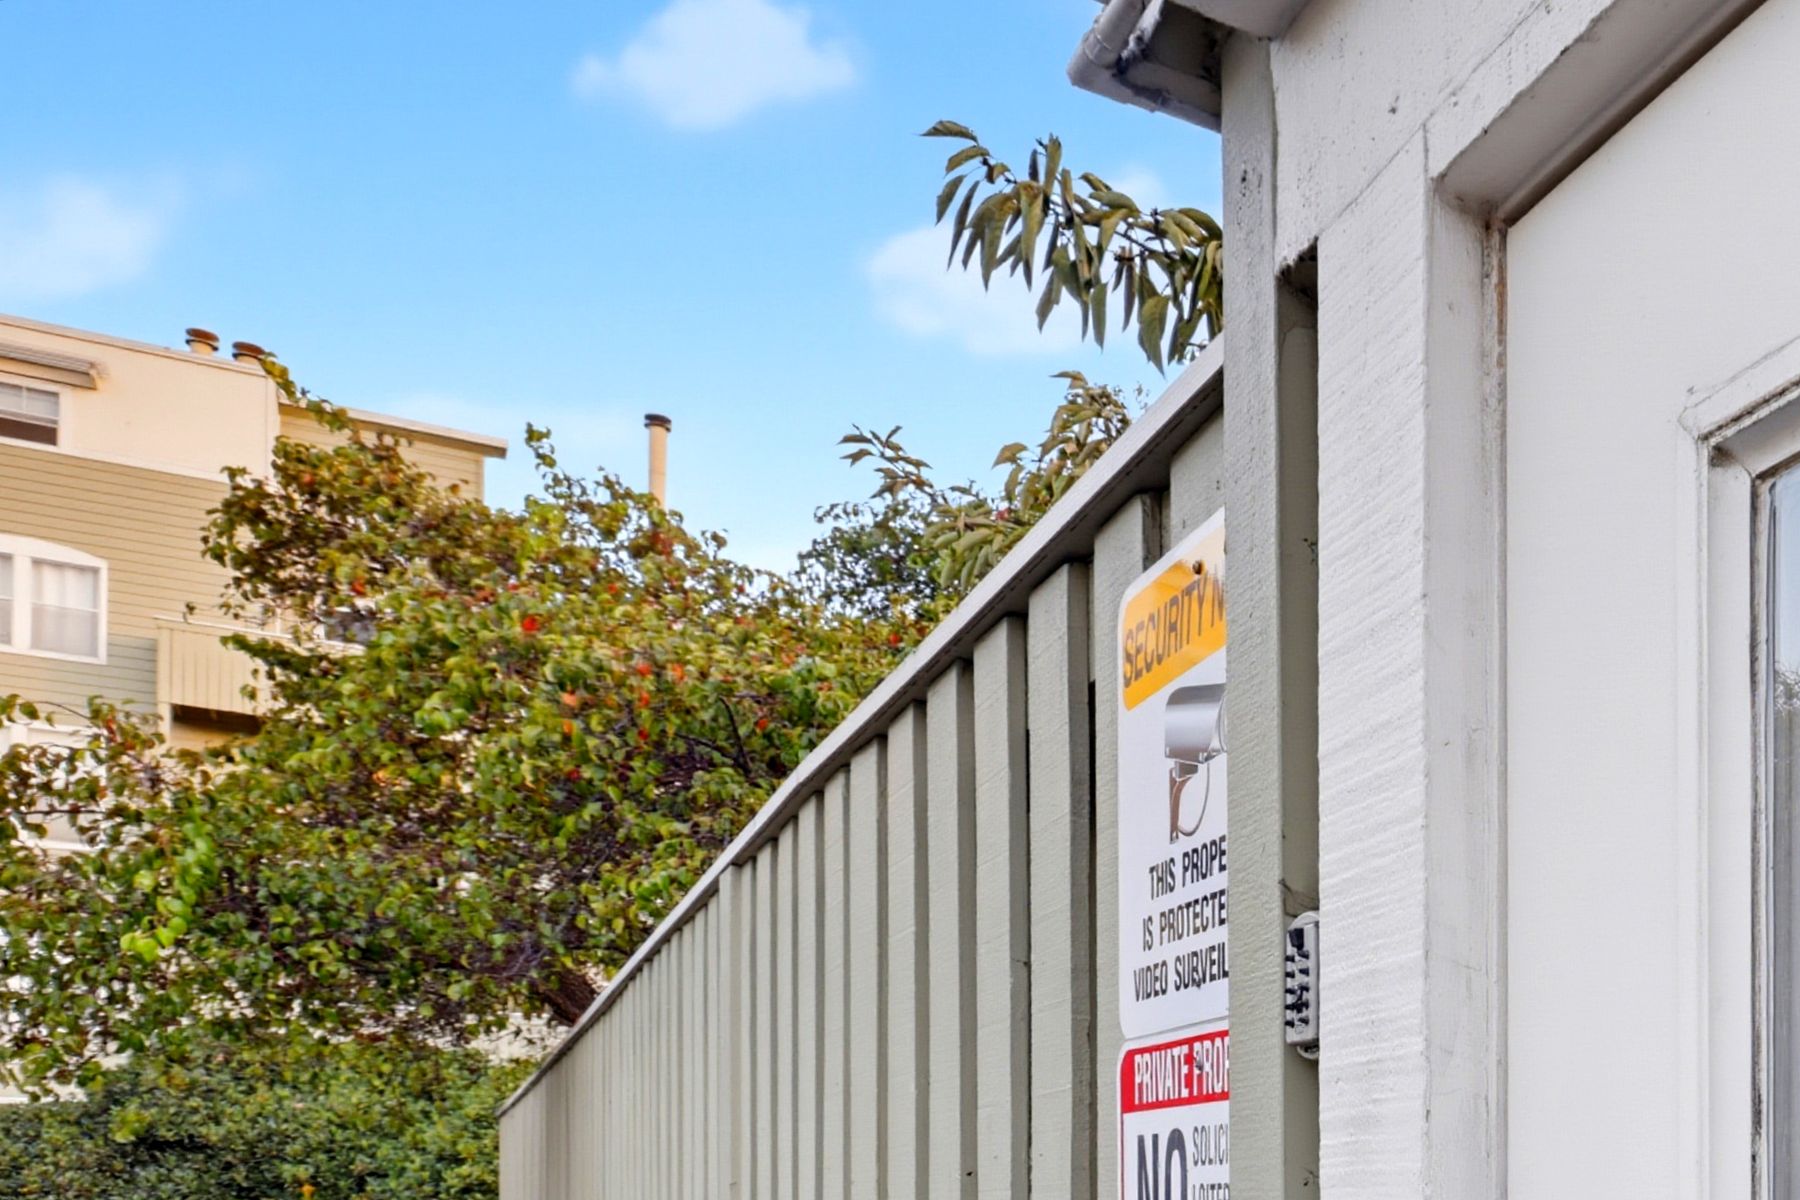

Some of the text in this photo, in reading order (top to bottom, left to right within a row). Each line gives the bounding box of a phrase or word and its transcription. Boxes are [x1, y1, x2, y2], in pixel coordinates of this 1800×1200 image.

[1123, 570, 1209, 688] SECURITY
[1149, 834, 1227, 900] THIS PROPE
[1143, 888, 1229, 952] IS PROTECTE
[1133, 960, 1168, 1002] VIDEO
[1134, 1044, 1189, 1105] PRIVATE
